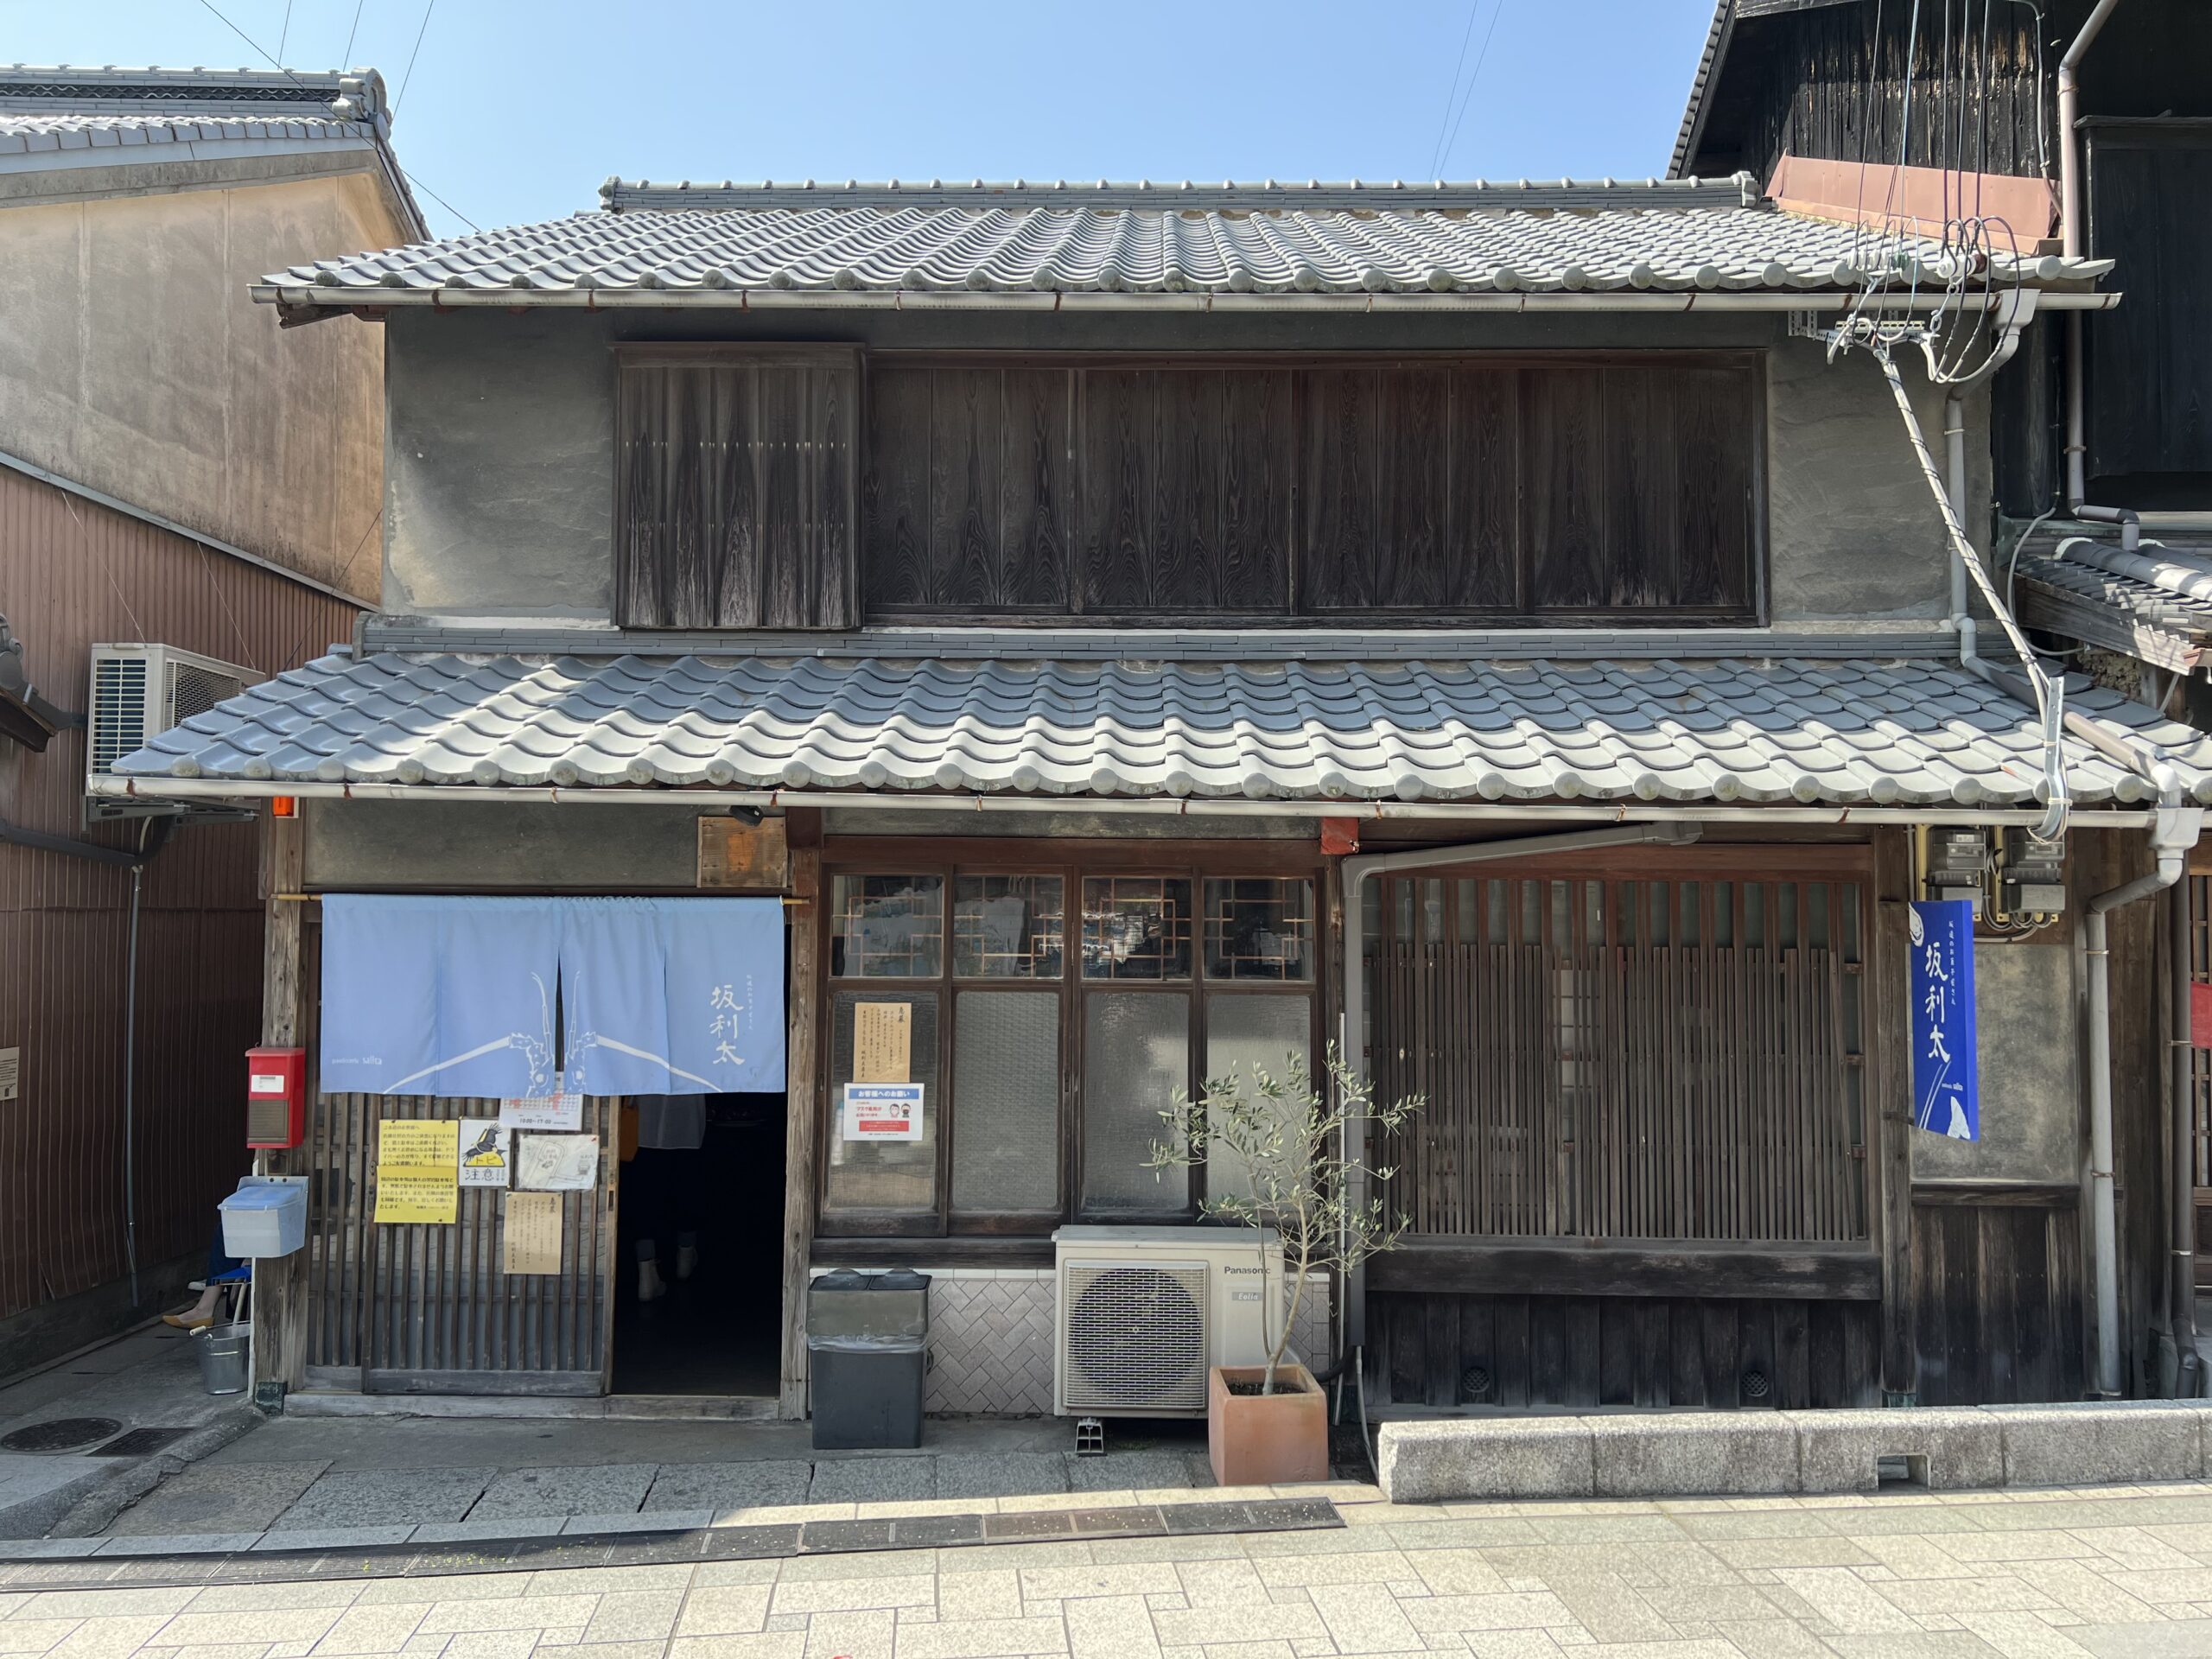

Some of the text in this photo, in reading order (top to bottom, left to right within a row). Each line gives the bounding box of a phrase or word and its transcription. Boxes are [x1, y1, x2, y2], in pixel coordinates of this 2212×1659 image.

[709, 984, 746, 1065] 坂利太
[1925, 941, 1950, 1063] 坂利太
[476, 1156, 497, 1165] トビ
